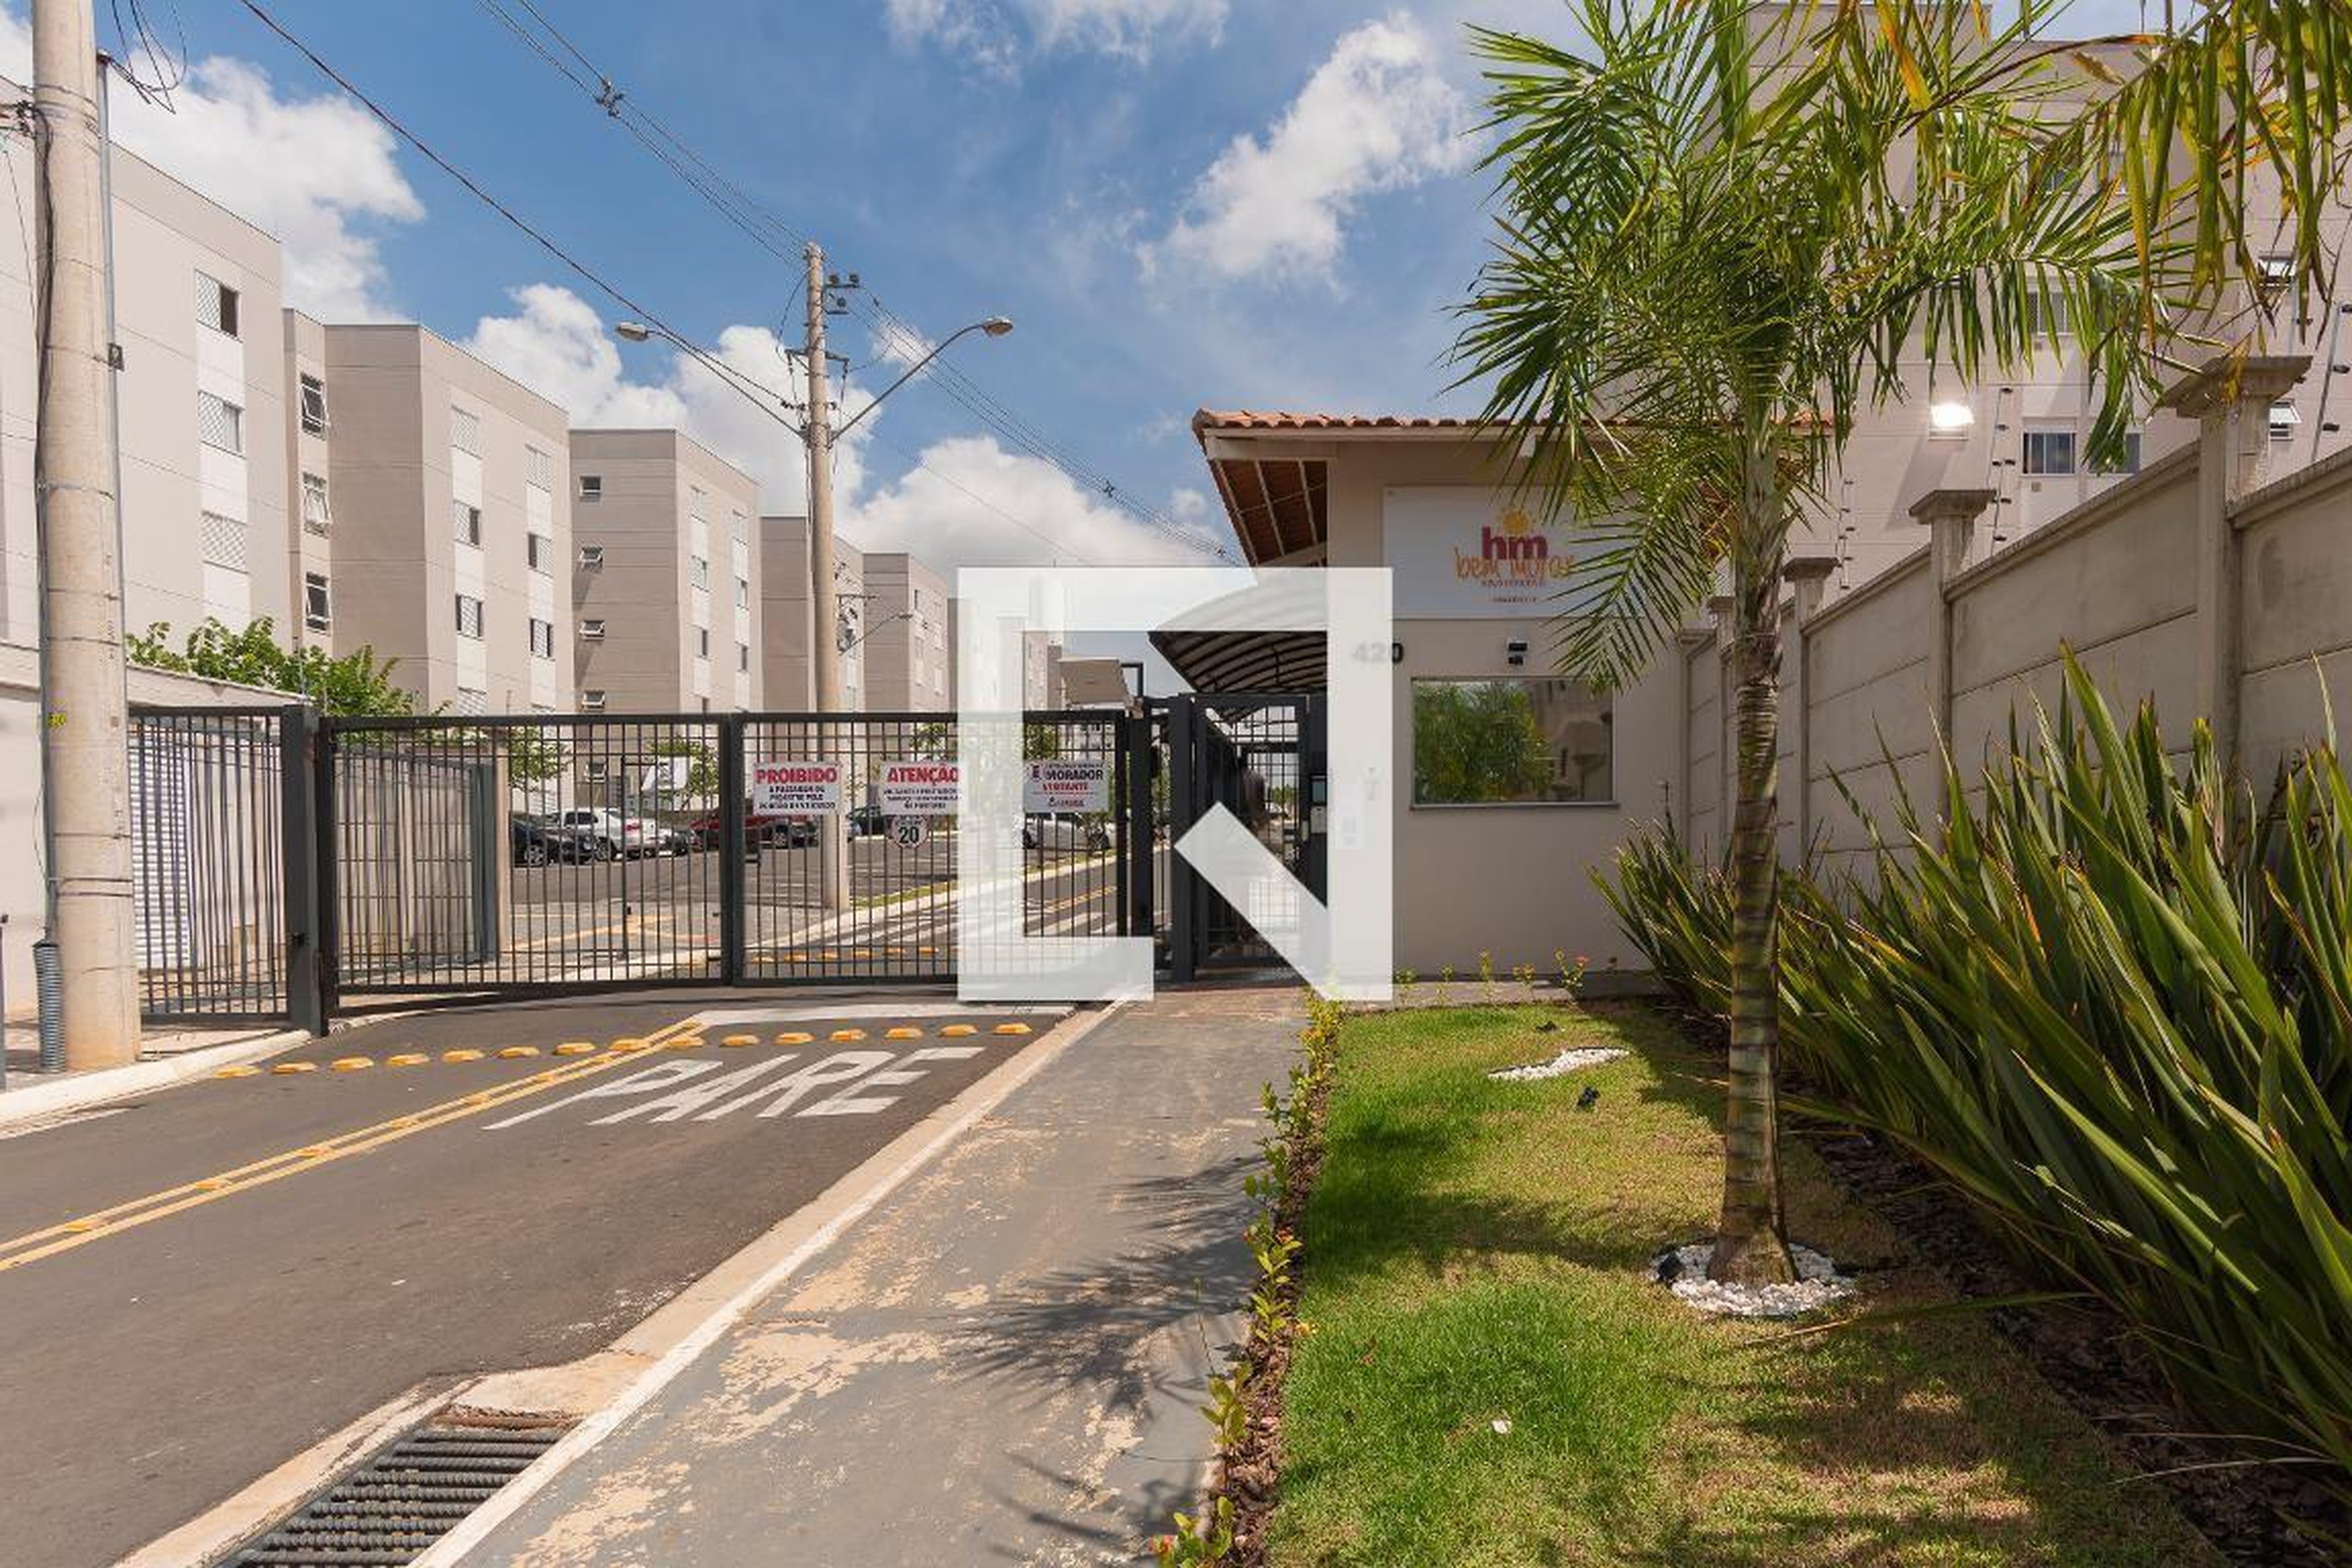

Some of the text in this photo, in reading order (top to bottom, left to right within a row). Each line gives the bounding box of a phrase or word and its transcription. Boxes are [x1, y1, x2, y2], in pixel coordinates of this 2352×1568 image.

[1482, 526, 1548, 560] hm
[756, 767, 837, 784] PROIBIDO
[887, 763, 960, 786] ATENÇÃO
[1045, 769, 1102, 780] MORADOR
[899, 827, 919, 843] 20
[480, 1046, 986, 1131] PARE
